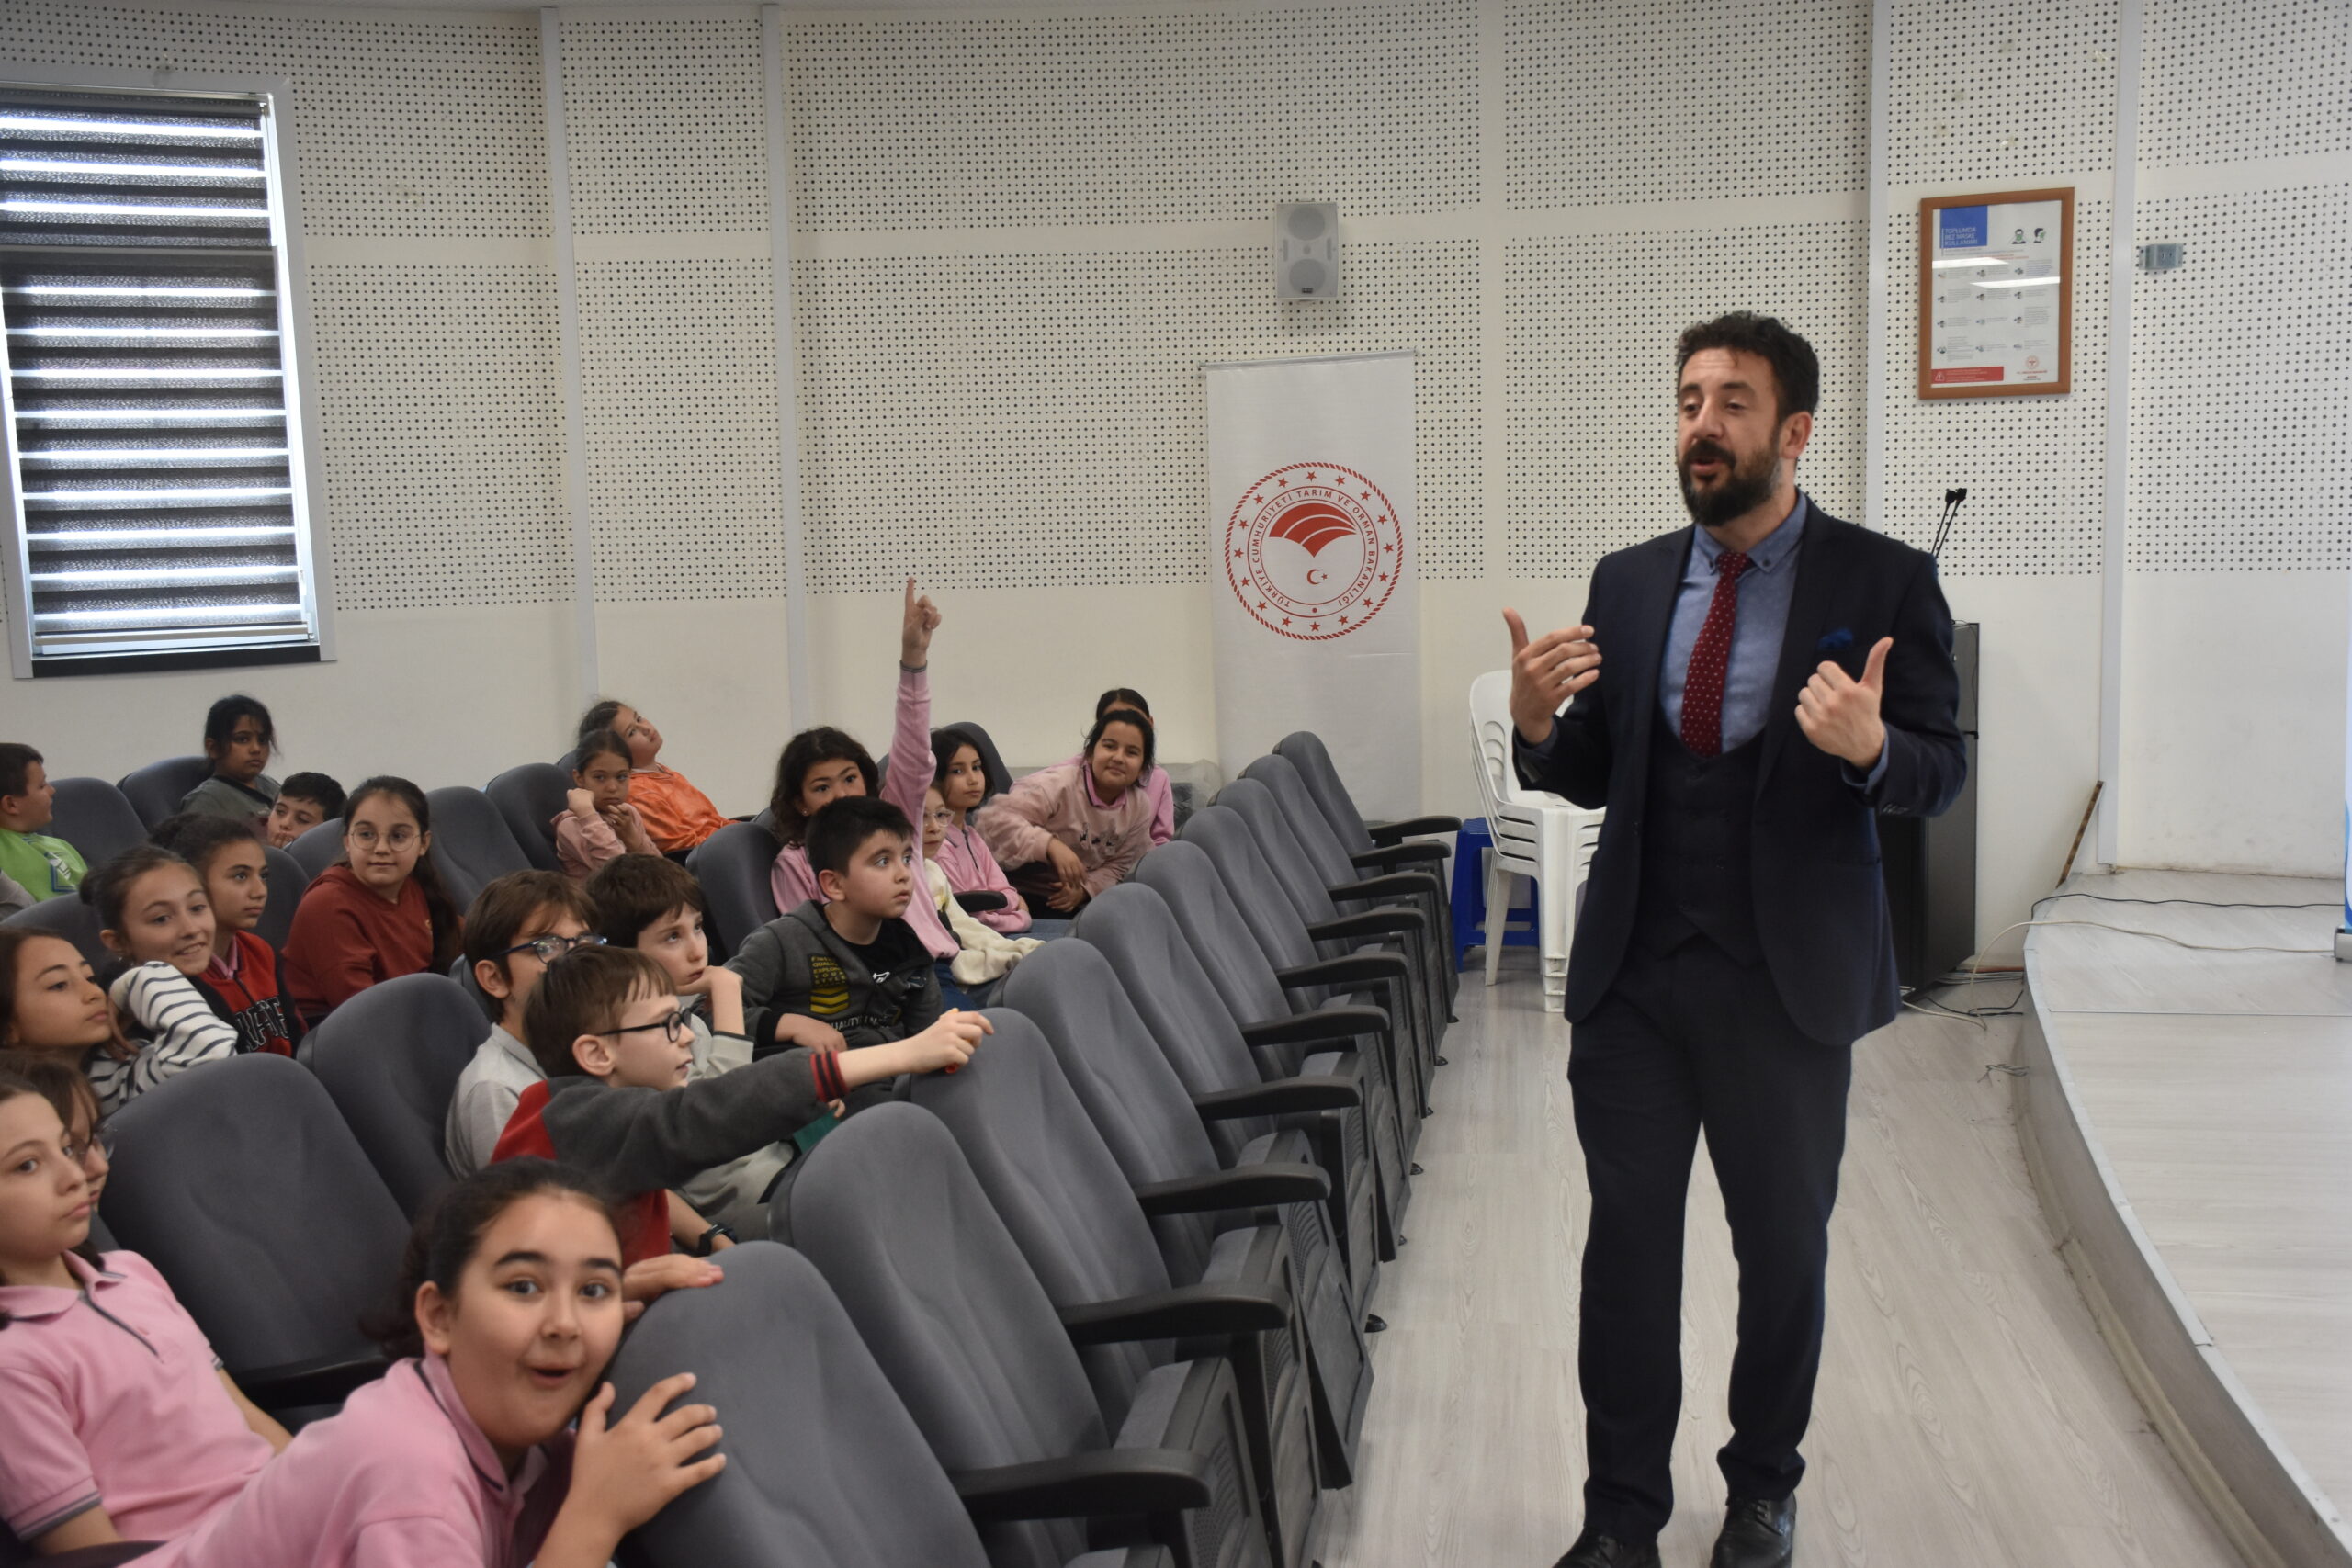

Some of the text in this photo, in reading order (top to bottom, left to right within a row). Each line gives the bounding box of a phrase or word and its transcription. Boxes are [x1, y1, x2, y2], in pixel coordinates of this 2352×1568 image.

[1251, 489, 1375, 608] TÜRKİYE CUMHURİYETİ TARIM VE ORMAN BAKANLIĞI
